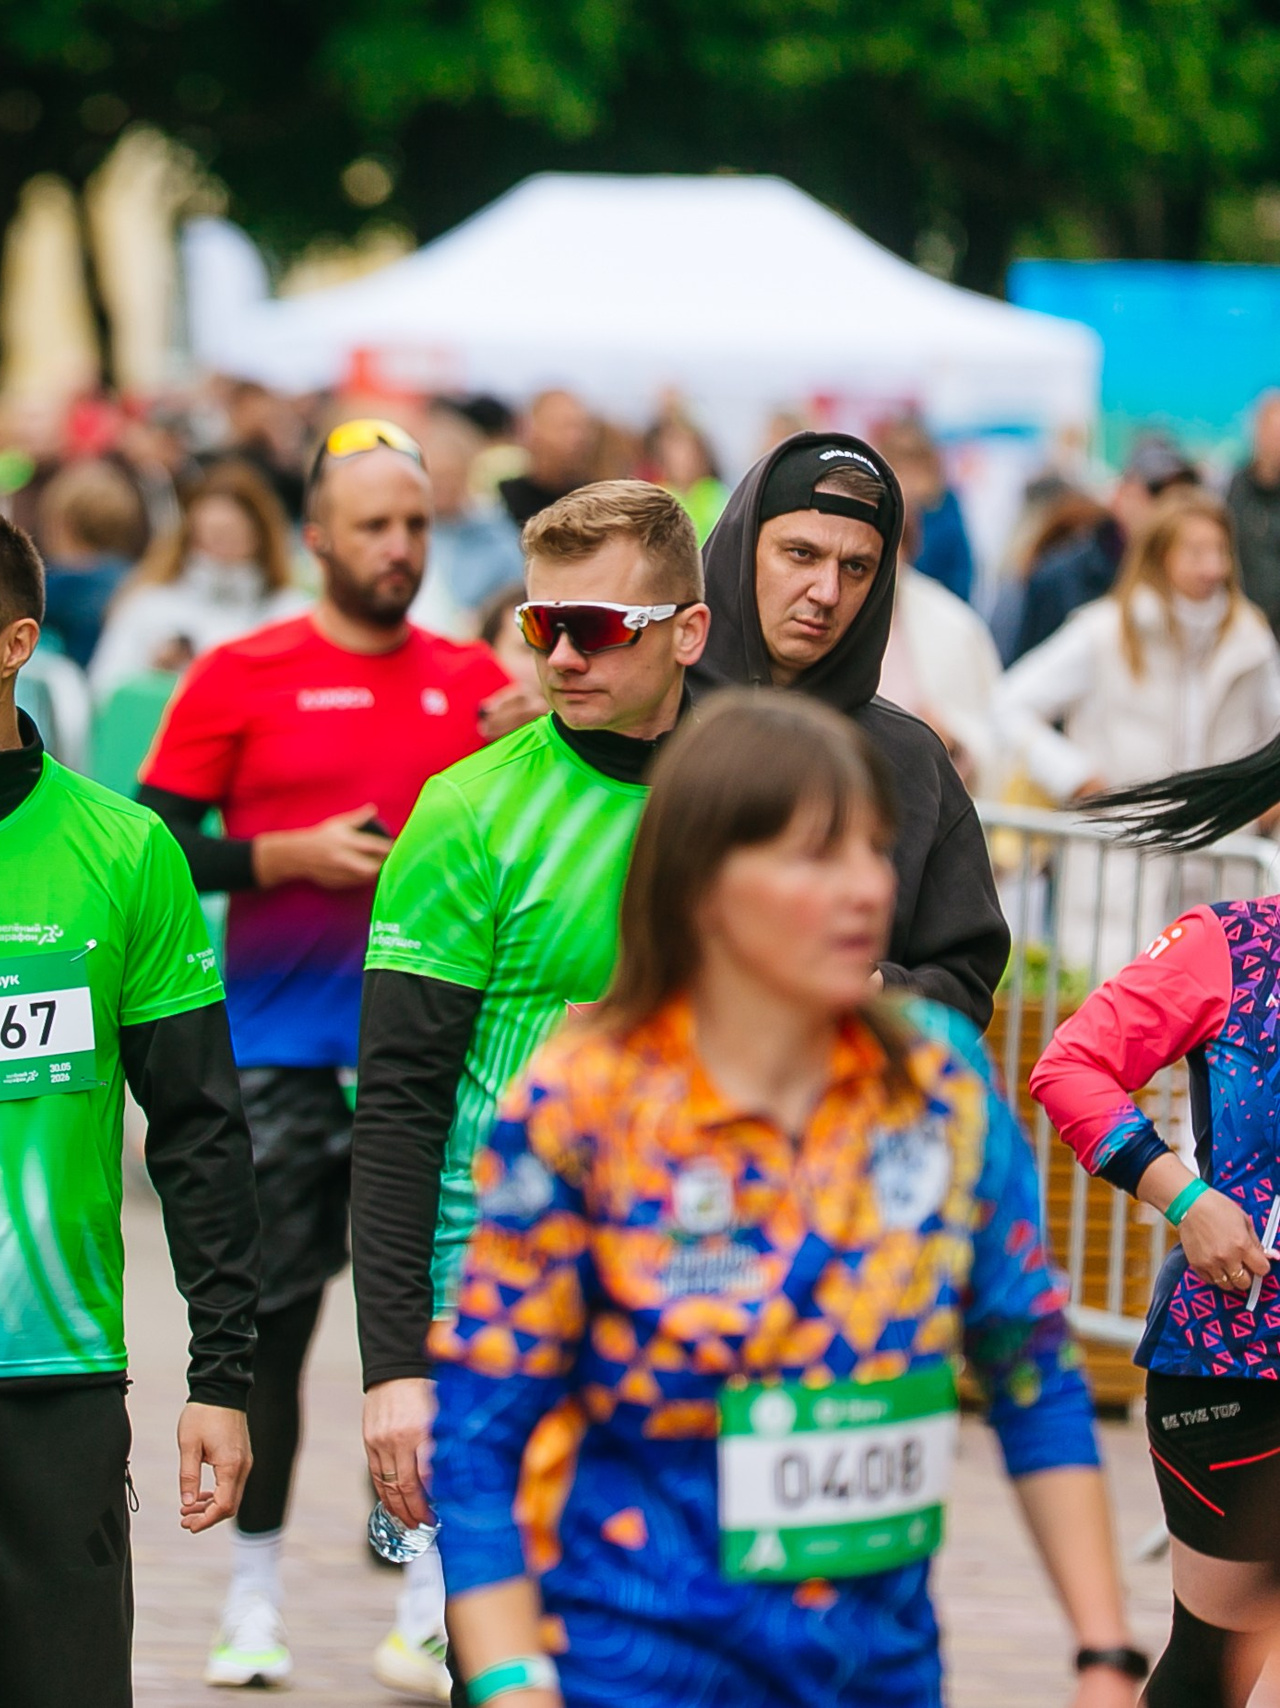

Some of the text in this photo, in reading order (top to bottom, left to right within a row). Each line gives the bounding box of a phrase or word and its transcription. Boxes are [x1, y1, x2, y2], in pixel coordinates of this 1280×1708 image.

[49, 1062, 72, 1073] 30.05
[50, 1073, 70, 1084] 2026
[1210, 1402, 1241, 1420] TOP
[773, 1437, 924, 1510] 0408
